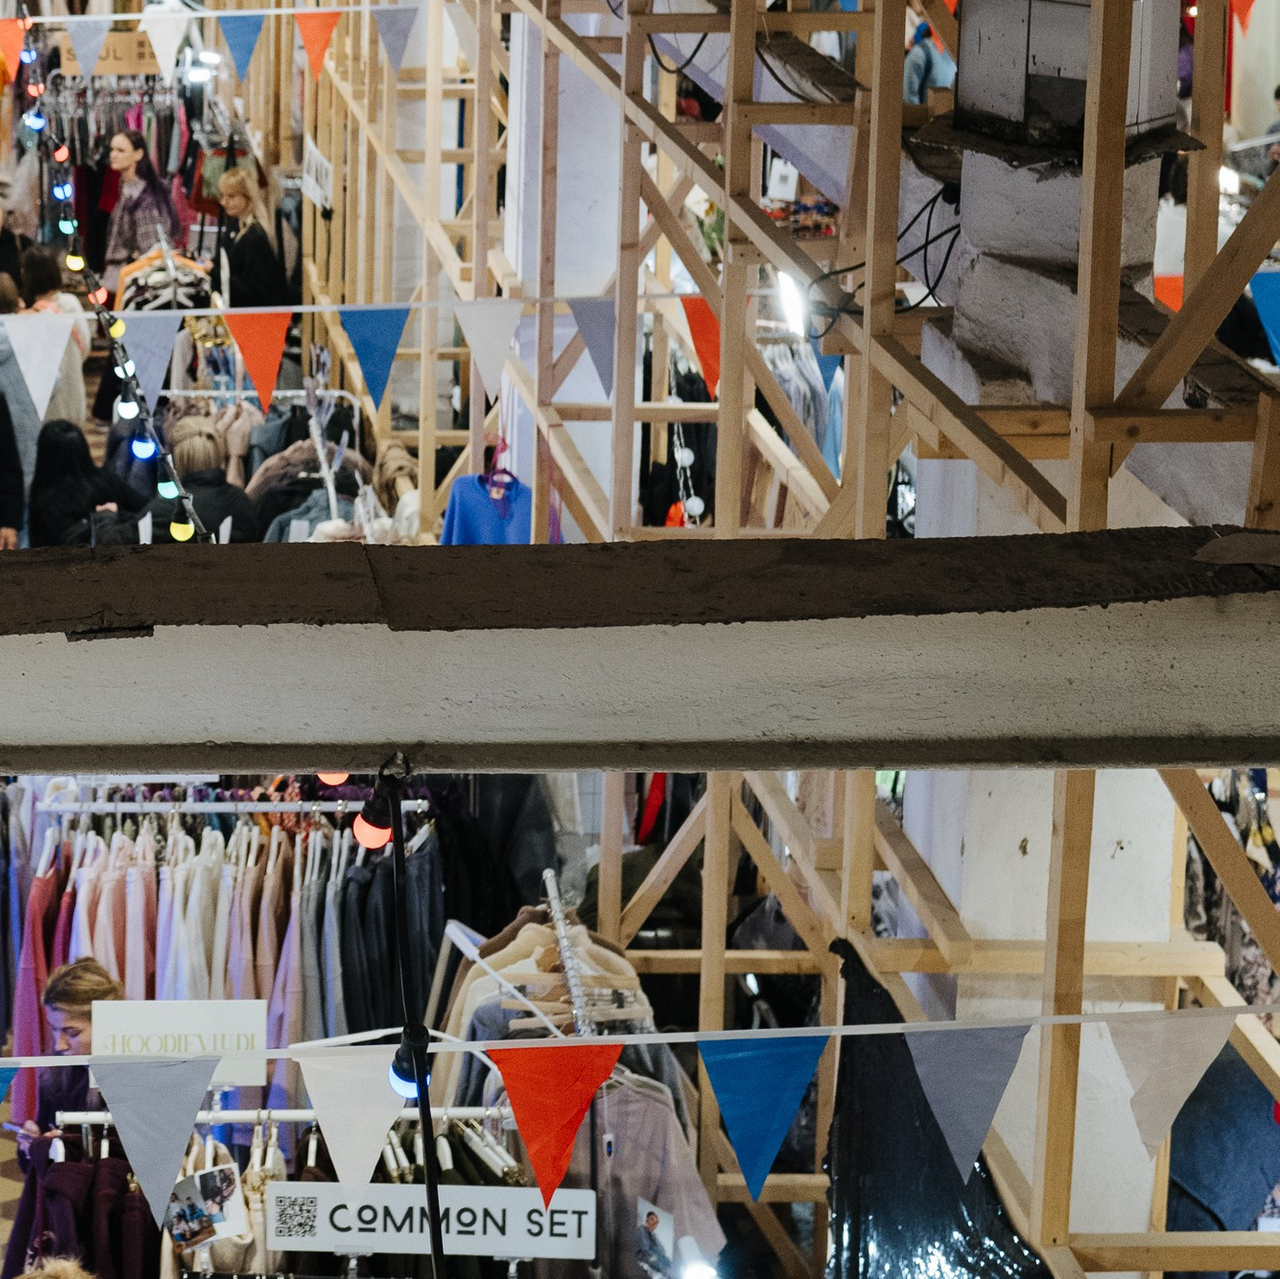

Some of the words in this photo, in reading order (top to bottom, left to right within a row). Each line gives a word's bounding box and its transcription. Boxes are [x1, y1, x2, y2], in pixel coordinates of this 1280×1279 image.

[66, 46, 123, 62] SUL
[329, 1204, 507, 1236] COMMON
[526, 1208, 588, 1238] SET
